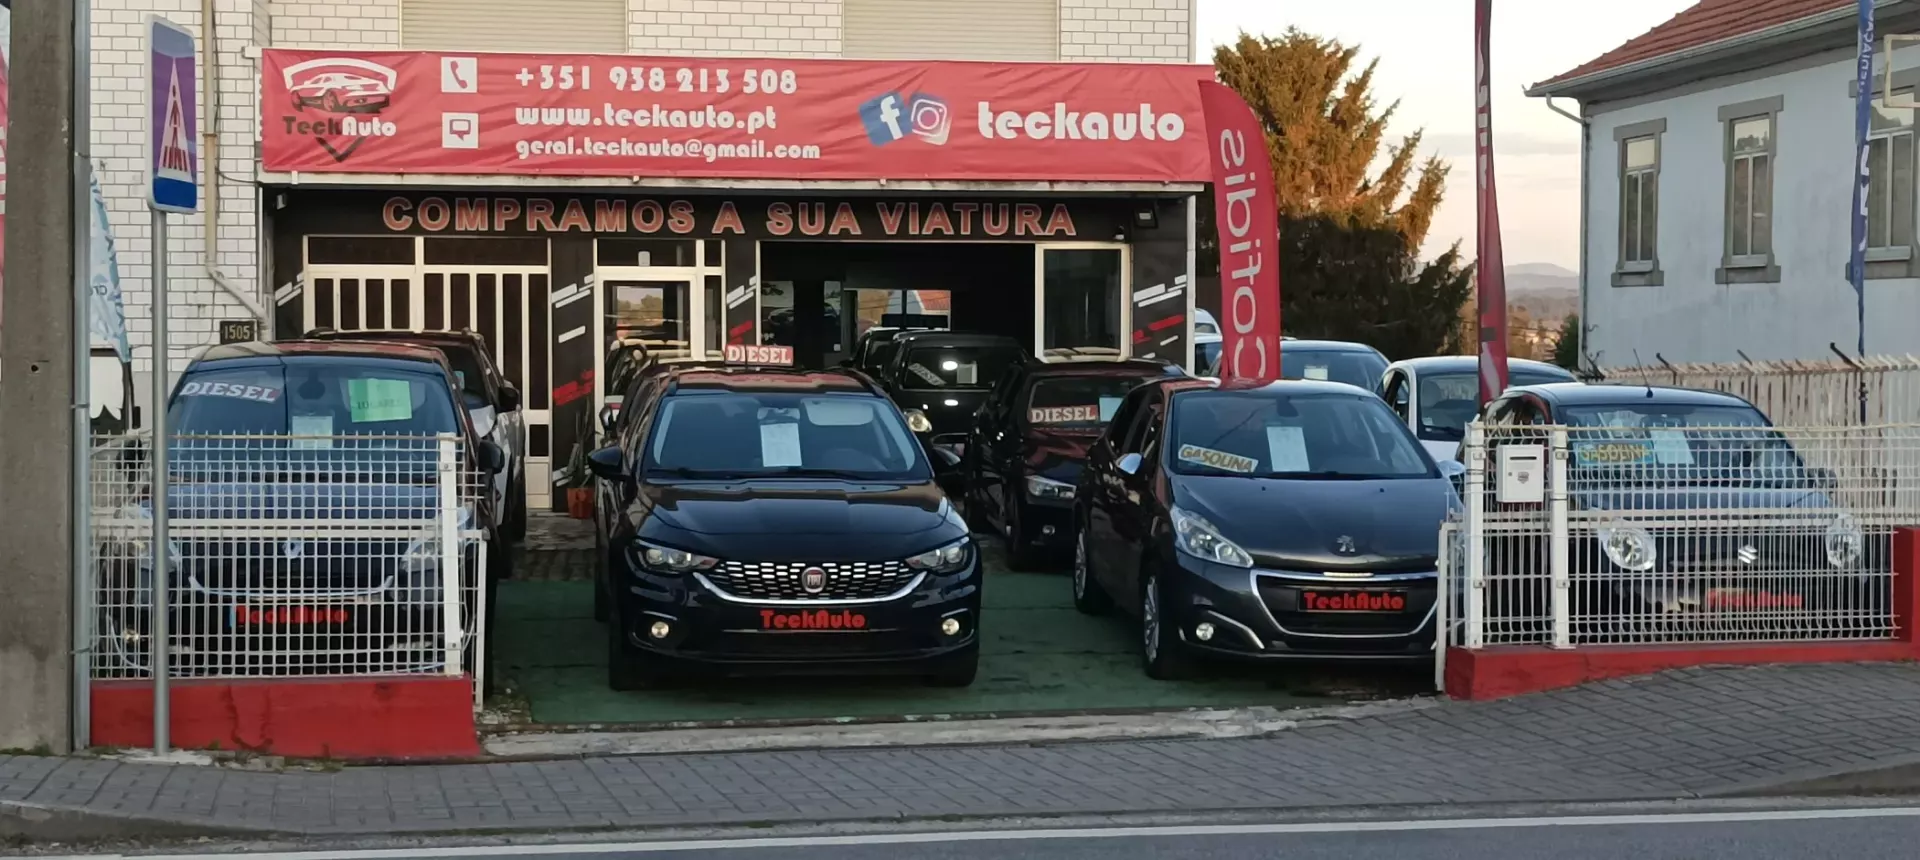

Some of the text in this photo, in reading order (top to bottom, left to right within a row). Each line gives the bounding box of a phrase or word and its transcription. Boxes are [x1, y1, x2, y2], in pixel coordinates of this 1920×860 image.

[515, 65, 797, 94] +351 938 213 508
[282, 115, 397, 137] TeckAuto
[515, 103, 777, 134] www.teckauto.pt
[977, 101, 1185, 141] teckauto
[515, 137, 821, 162] geral.teckauto@gmail.com
[382, 196, 1077, 236] COMPRAMOS A SUA VIATURA
[223, 324, 251, 340] 1505
[728, 345, 792, 364] DIESEL
[179, 381, 276, 402] DIESEL
[1031, 406, 1097, 423] DIESEL
[1179, 445, 1255, 473] GASOLINA
[1303, 591, 1404, 610] TeckAuto
[760, 609, 866, 628] TeckAuto
